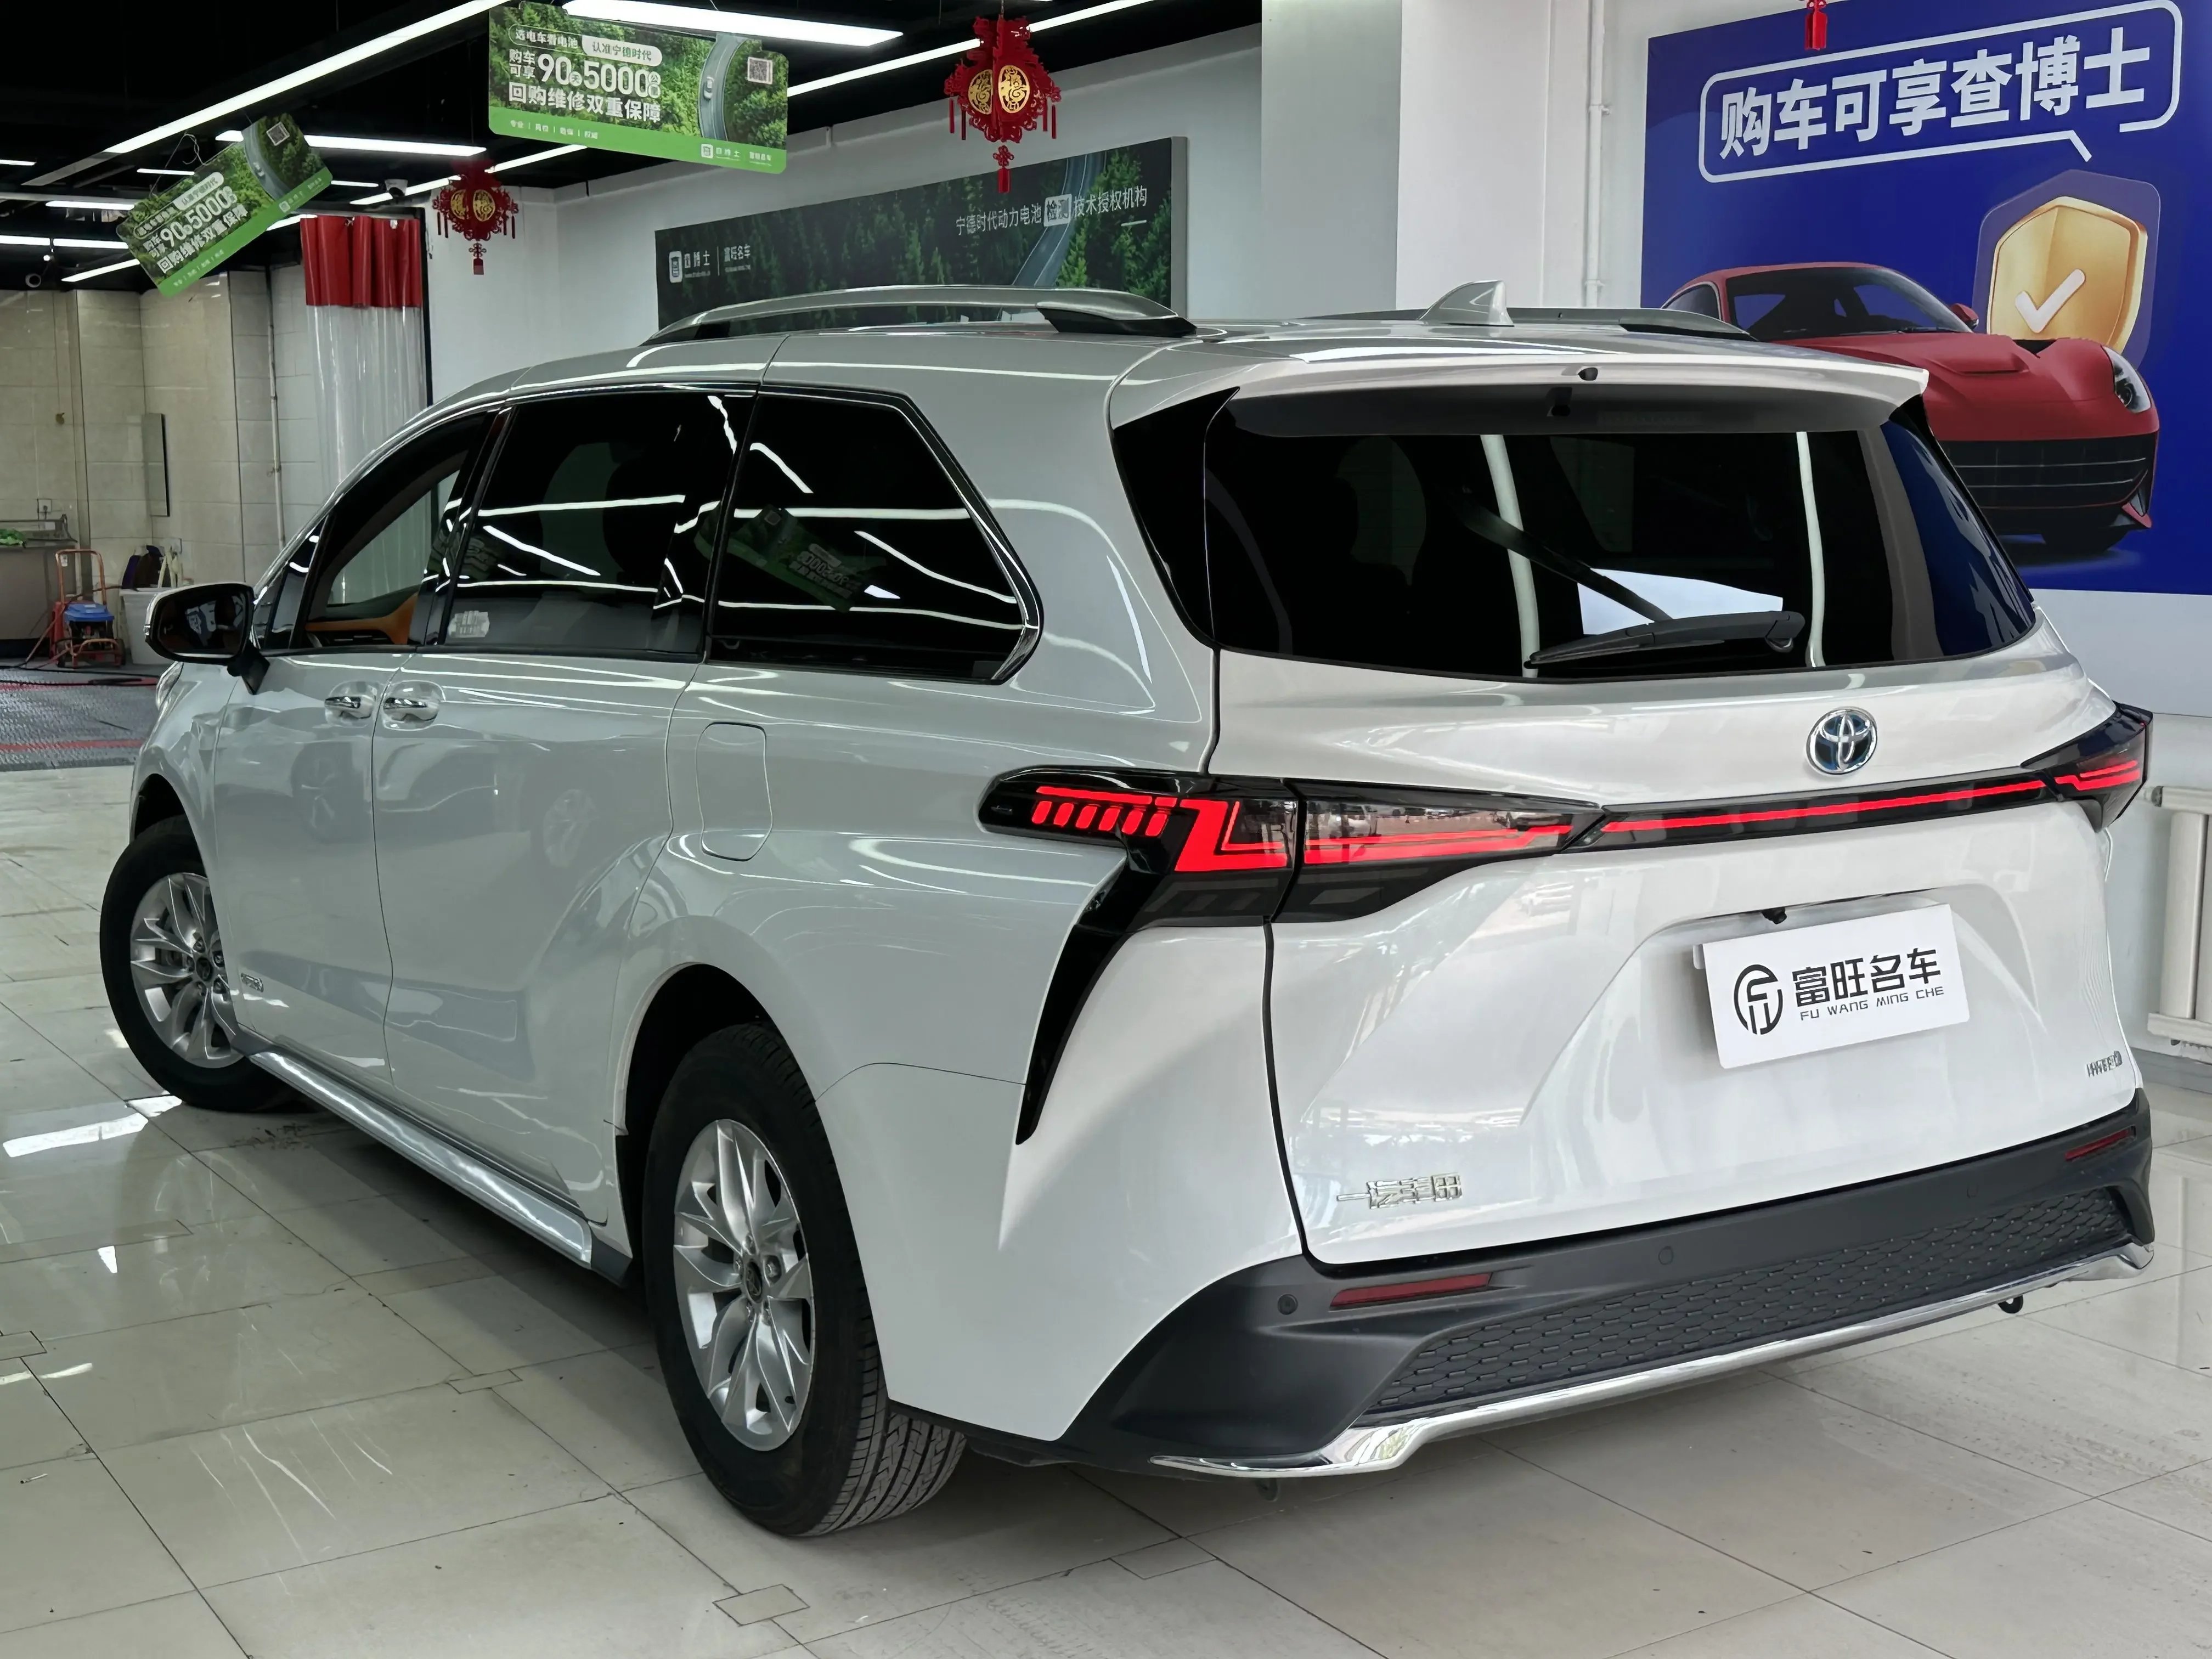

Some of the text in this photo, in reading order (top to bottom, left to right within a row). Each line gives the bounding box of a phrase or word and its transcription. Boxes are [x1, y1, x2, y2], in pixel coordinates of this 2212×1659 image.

[509, 81, 661, 123] 回购维修双重保障
[1719, 26, 2151, 160] 购车可享查博士
[1792, 948, 1941, 1007] 富旺名车
[1800, 986, 1945, 1021] FU WANG MING CHE
